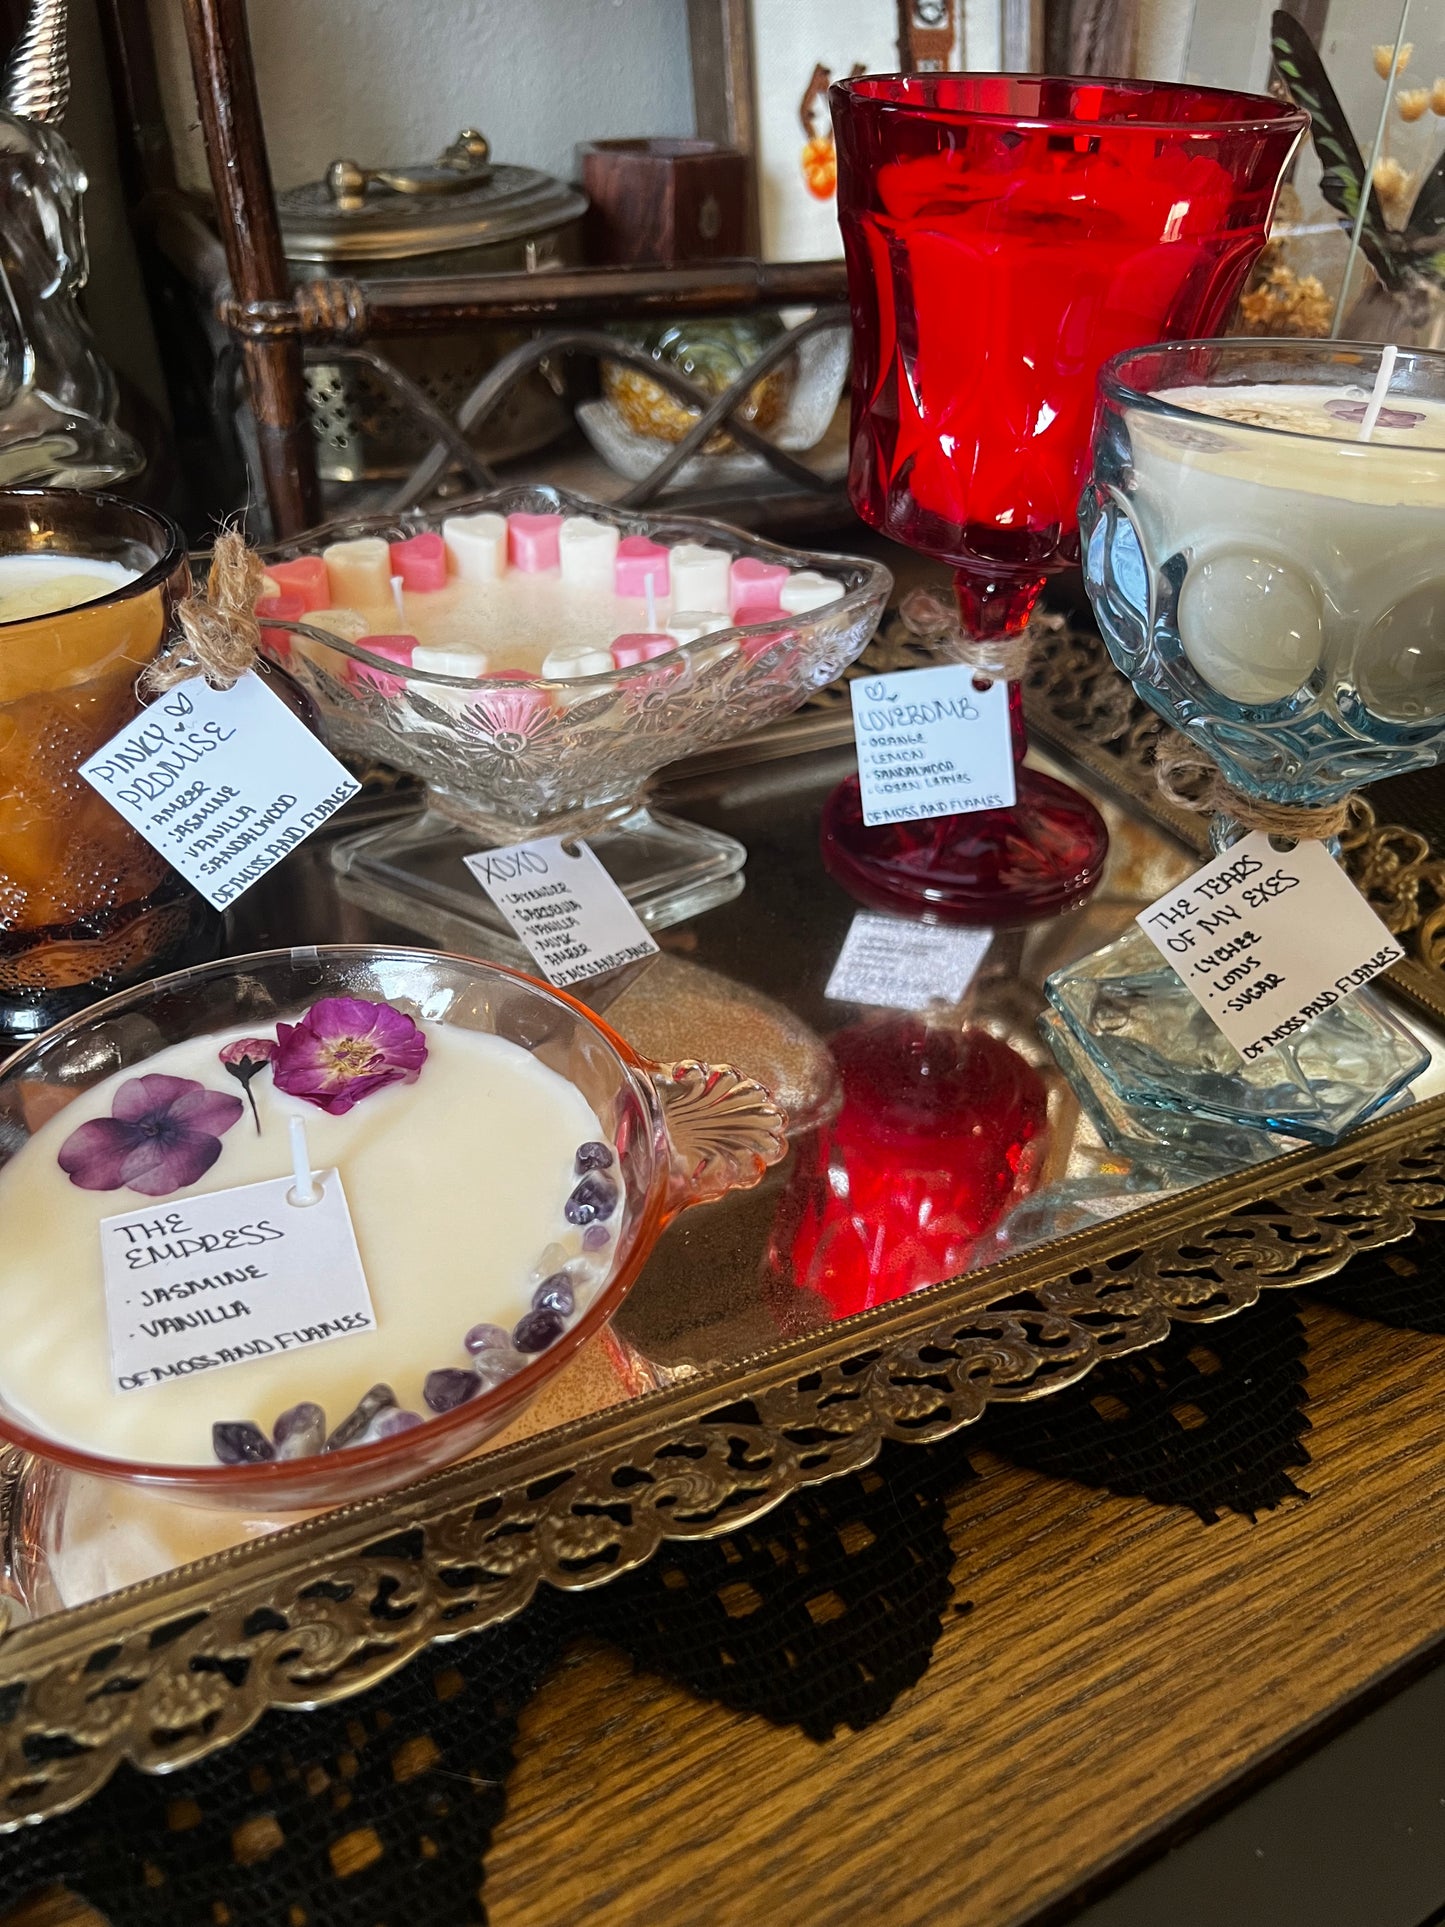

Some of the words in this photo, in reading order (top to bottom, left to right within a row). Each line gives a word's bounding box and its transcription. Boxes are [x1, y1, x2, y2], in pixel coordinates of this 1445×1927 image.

[858, 697, 979, 731] LOVEBOMB
[89, 723, 175, 783] PINKY
[870, 733, 928, 746] ORANGE
[872, 750, 925, 764] LEMON
[117, 721, 237, 811] PROMISE
[873, 761, 954, 780] SANDALWOOD
[151, 780, 211, 825] AMBER
[168, 785, 240, 843] JASMINE
[185, 805, 256, 858] VANILLA
[200, 794, 298, 875] SANDALWOOD
[472, 850, 548, 885] XOXO
[1148, 899, 1199, 930] THE
[1194, 854, 1263, 900] TEARS
[1167, 929, 1197, 953] OF
[1196, 905, 1242, 935] MY
[1242, 869, 1300, 907] EXES
[526, 917, 580, 936] VANILLA
[536, 933, 576, 951] MUSK
[546, 943, 592, 966] AMBER
[1194, 930, 1262, 974] LYCHEE
[1213, 956, 1261, 993] LOTUS
[1227, 973, 1286, 1012] SUGAR
[113, 1213, 193, 1243] THE
[125, 1220, 285, 1270] EMPRESS
[140, 1264, 269, 1307] JASMINE
[140, 1300, 252, 1338] VANILLA
